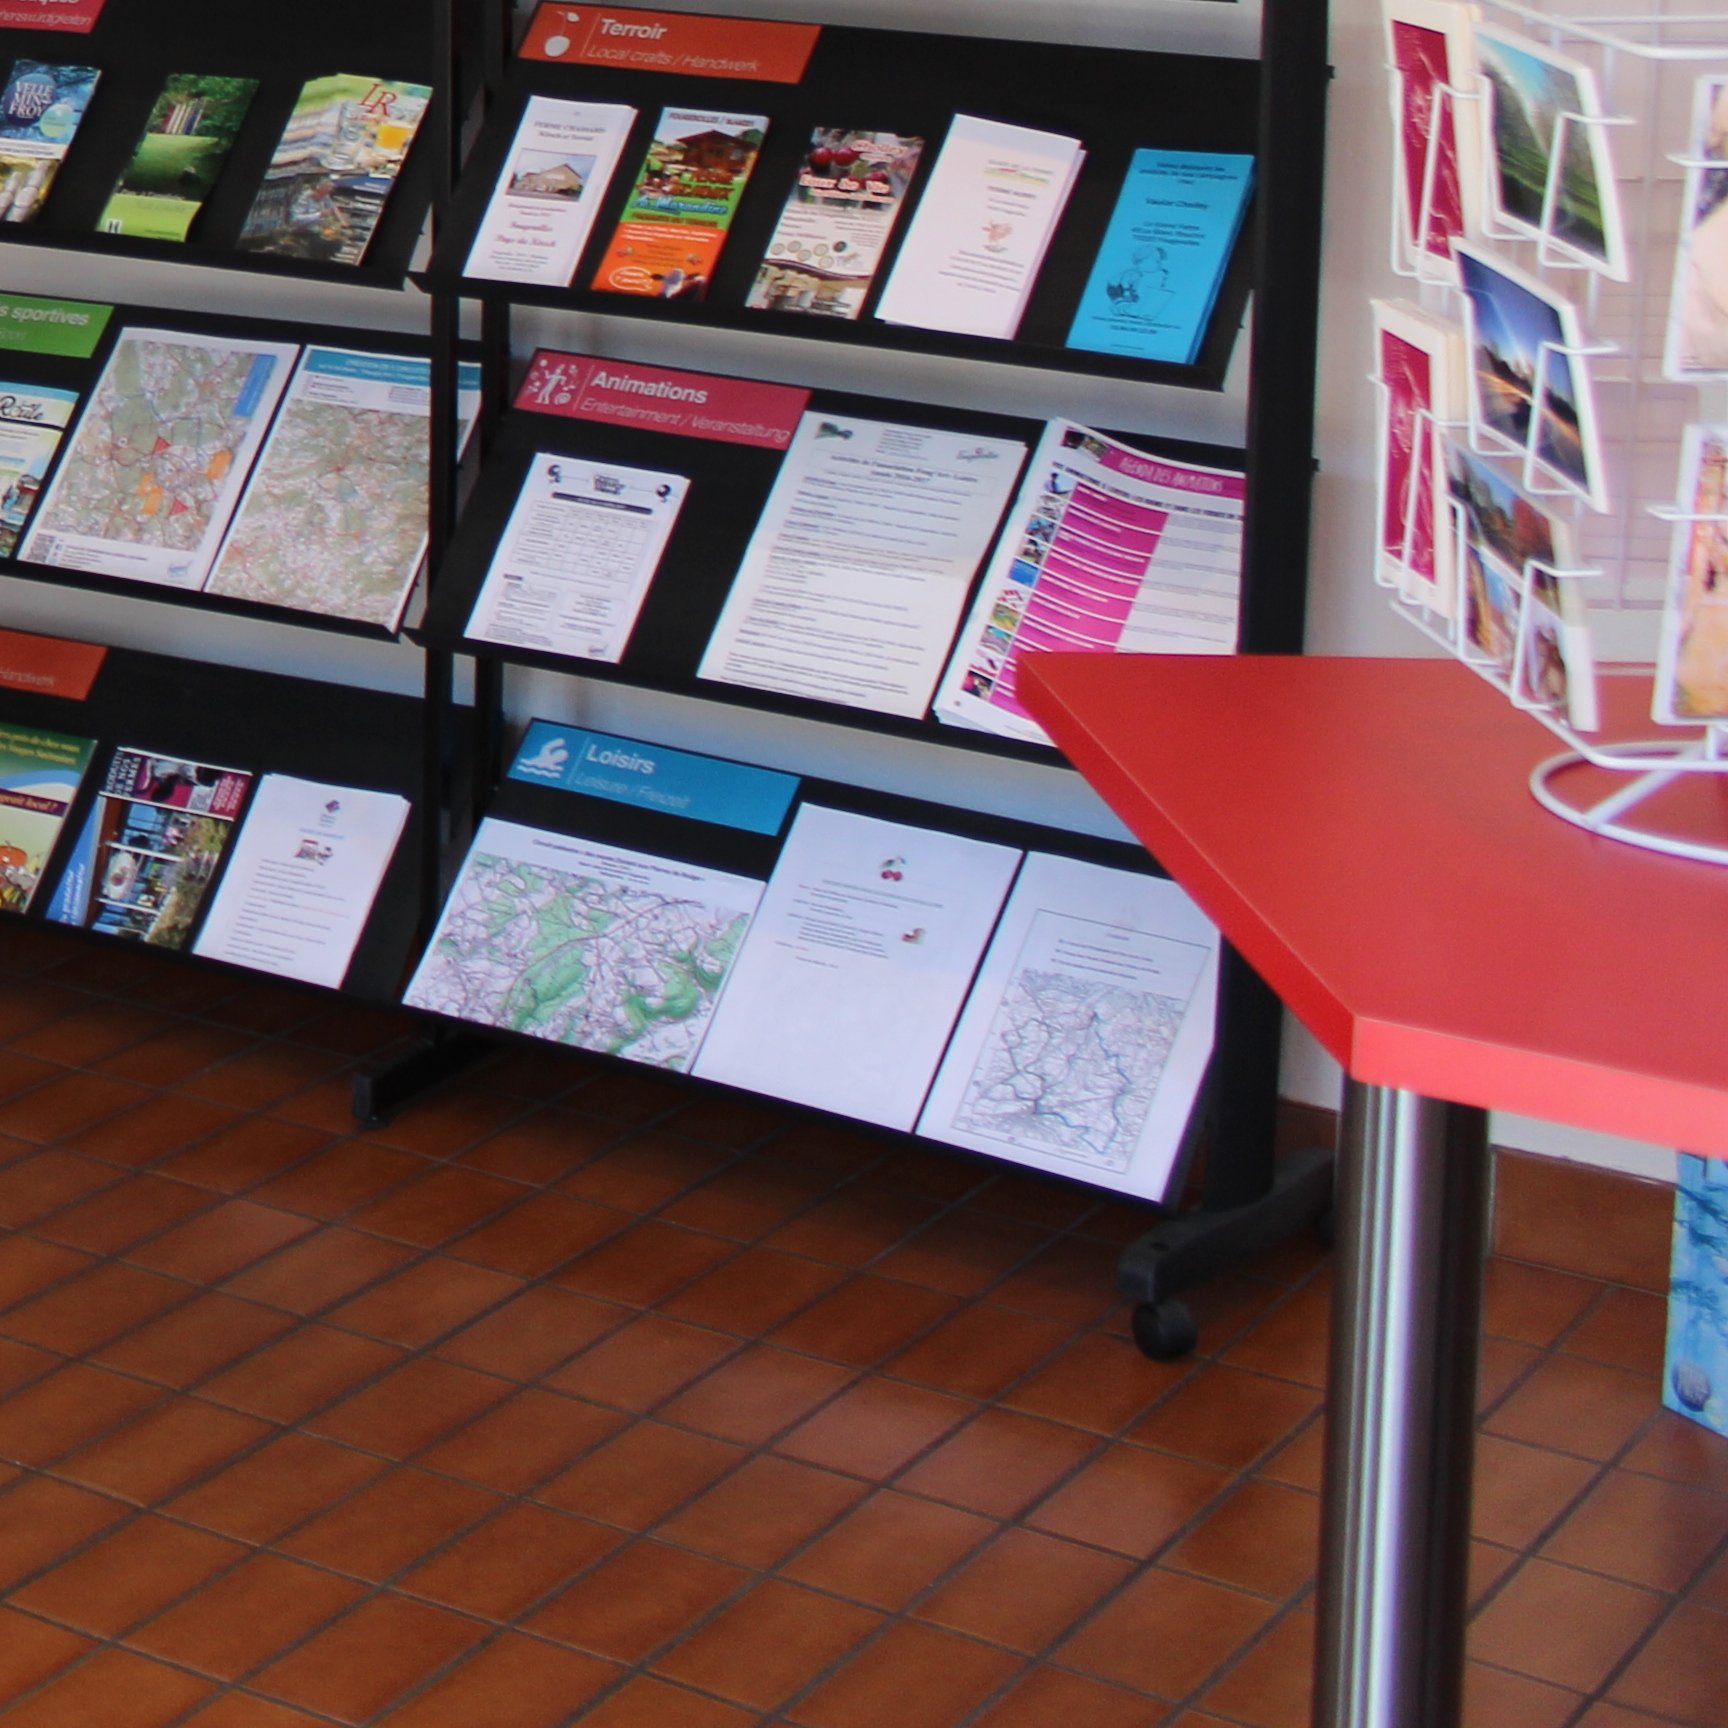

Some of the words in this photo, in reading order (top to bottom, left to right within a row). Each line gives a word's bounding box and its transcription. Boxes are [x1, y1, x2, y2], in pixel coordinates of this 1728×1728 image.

[599, 17, 667, 41] Terroir
[587, 44, 630, 63] Local
[631, 47, 671, 67] crafts
[682, 53, 759, 72] Handwerk
[11, 305, 91, 327] sportives
[590, 370, 708, 405] Animations
[580, 396, 681, 426] Entertainment
[692, 414, 791, 443] Veranstaltung
[586, 743, 655, 775] Loisirs
